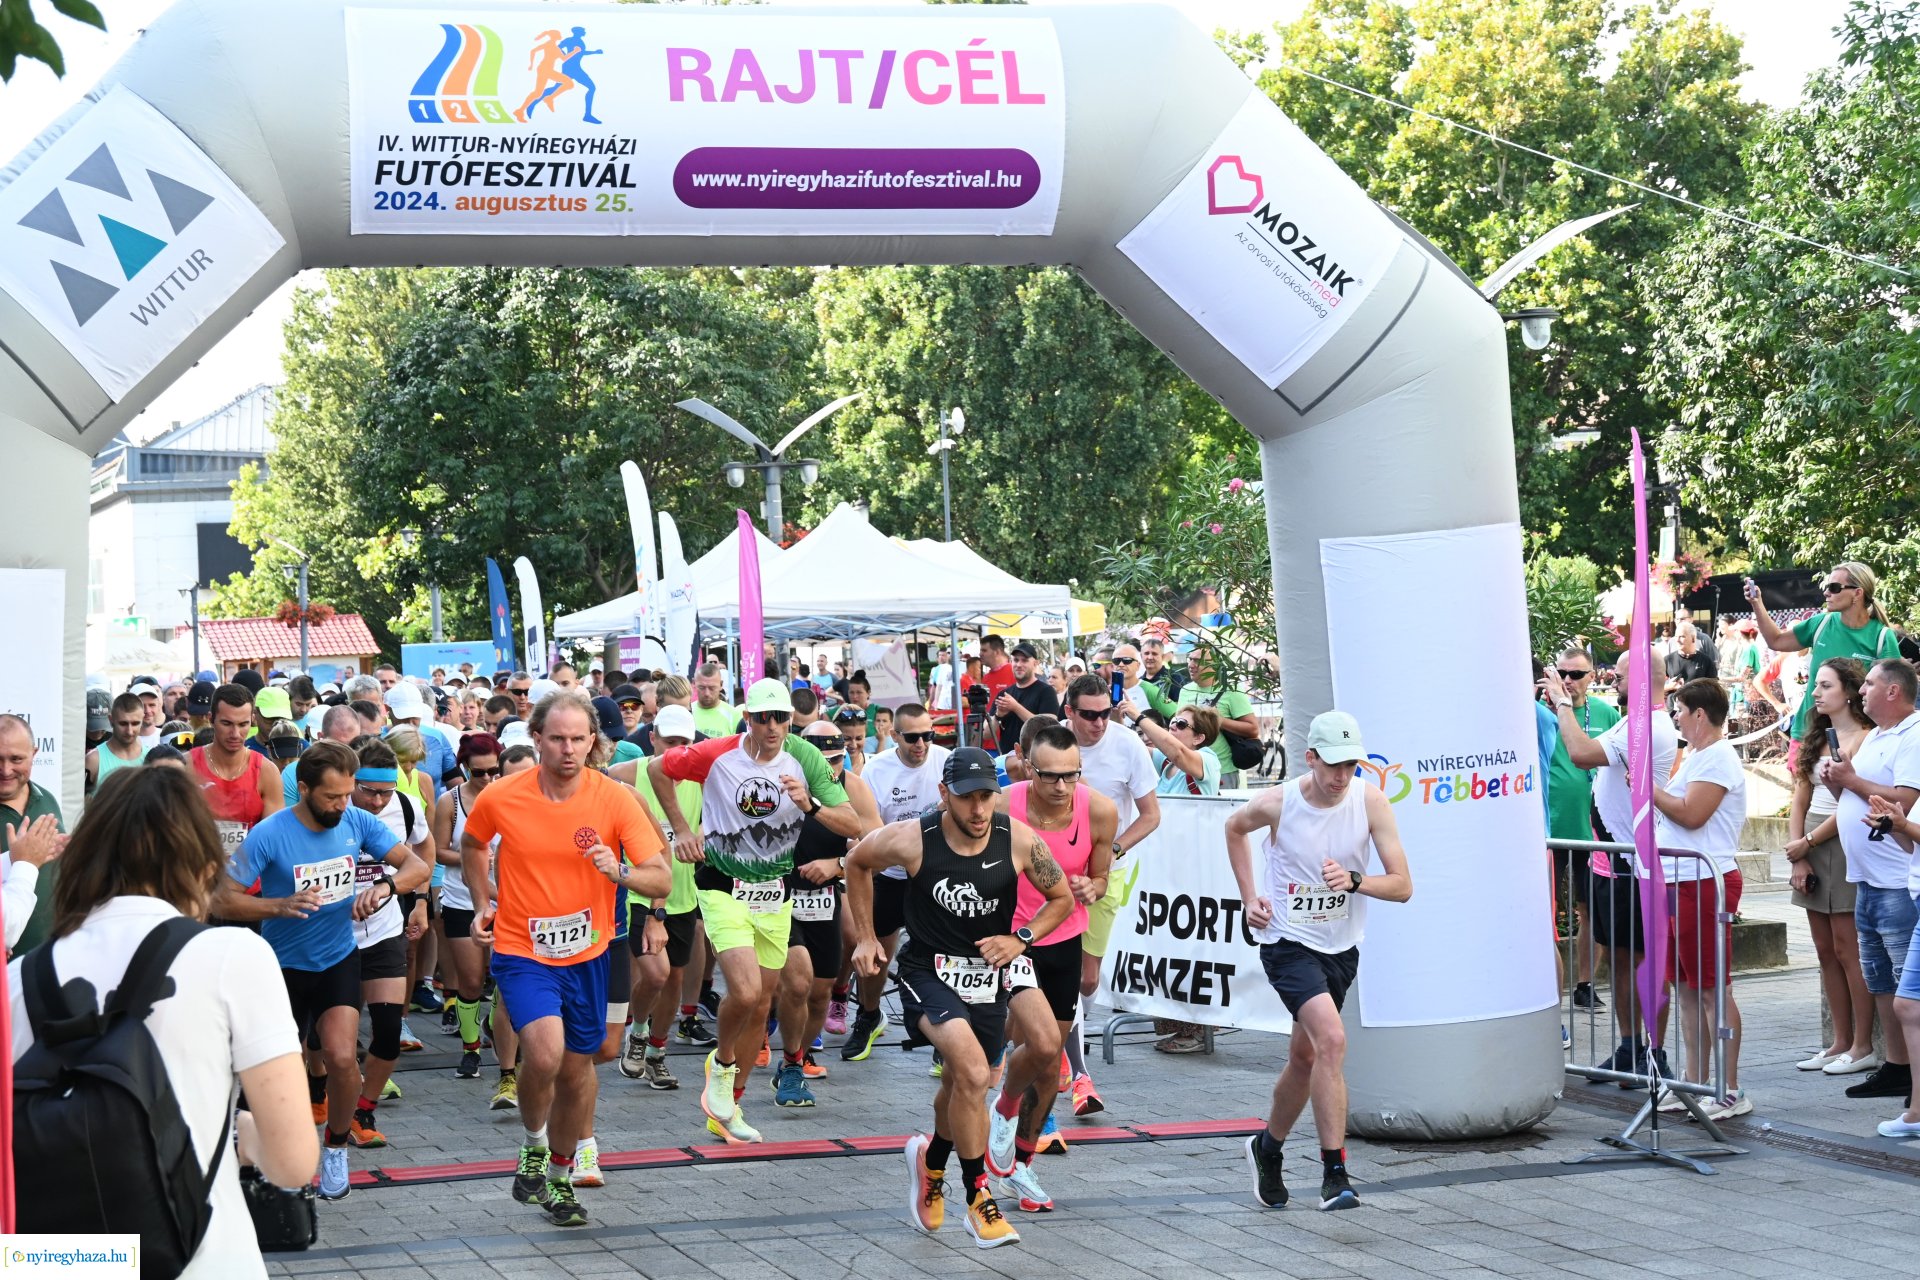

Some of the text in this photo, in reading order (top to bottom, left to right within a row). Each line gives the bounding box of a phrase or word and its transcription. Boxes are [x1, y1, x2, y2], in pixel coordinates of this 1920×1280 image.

[666, 38, 1046, 110] RAJT/CÉL
[378, 133, 637, 155] IV. WITTUR-NYÍREGYHÁZI
[374, 154, 637, 188] FUTÓFESZTIVÁL
[692, 169, 1022, 191] www.nyiregyhazifutofesztival.hu
[374, 191, 634, 215] 2024. augusztus 25.
[1254, 202, 1355, 298] MOZAIK
[1235, 231, 1328, 319] Az orvosi futóközösség
[129, 248, 214, 326] WITTUR
[1310, 278, 1341, 309] med
[1343, 730, 1350, 739] R
[1418, 750, 1517, 772] NYÍREGYHÁZA
[1419, 772, 1508, 804] Többet
[302, 871, 351, 890] 21112
[736, 890, 781, 902] 21209
[792, 897, 831, 909] 21210
[951, 899, 999, 911] DRAGON
[1293, 894, 1346, 911] 21139
[536, 924, 587, 946] 21121
[941, 972, 994, 988] 21054
[1111, 950, 1235, 1007] NEMZET
